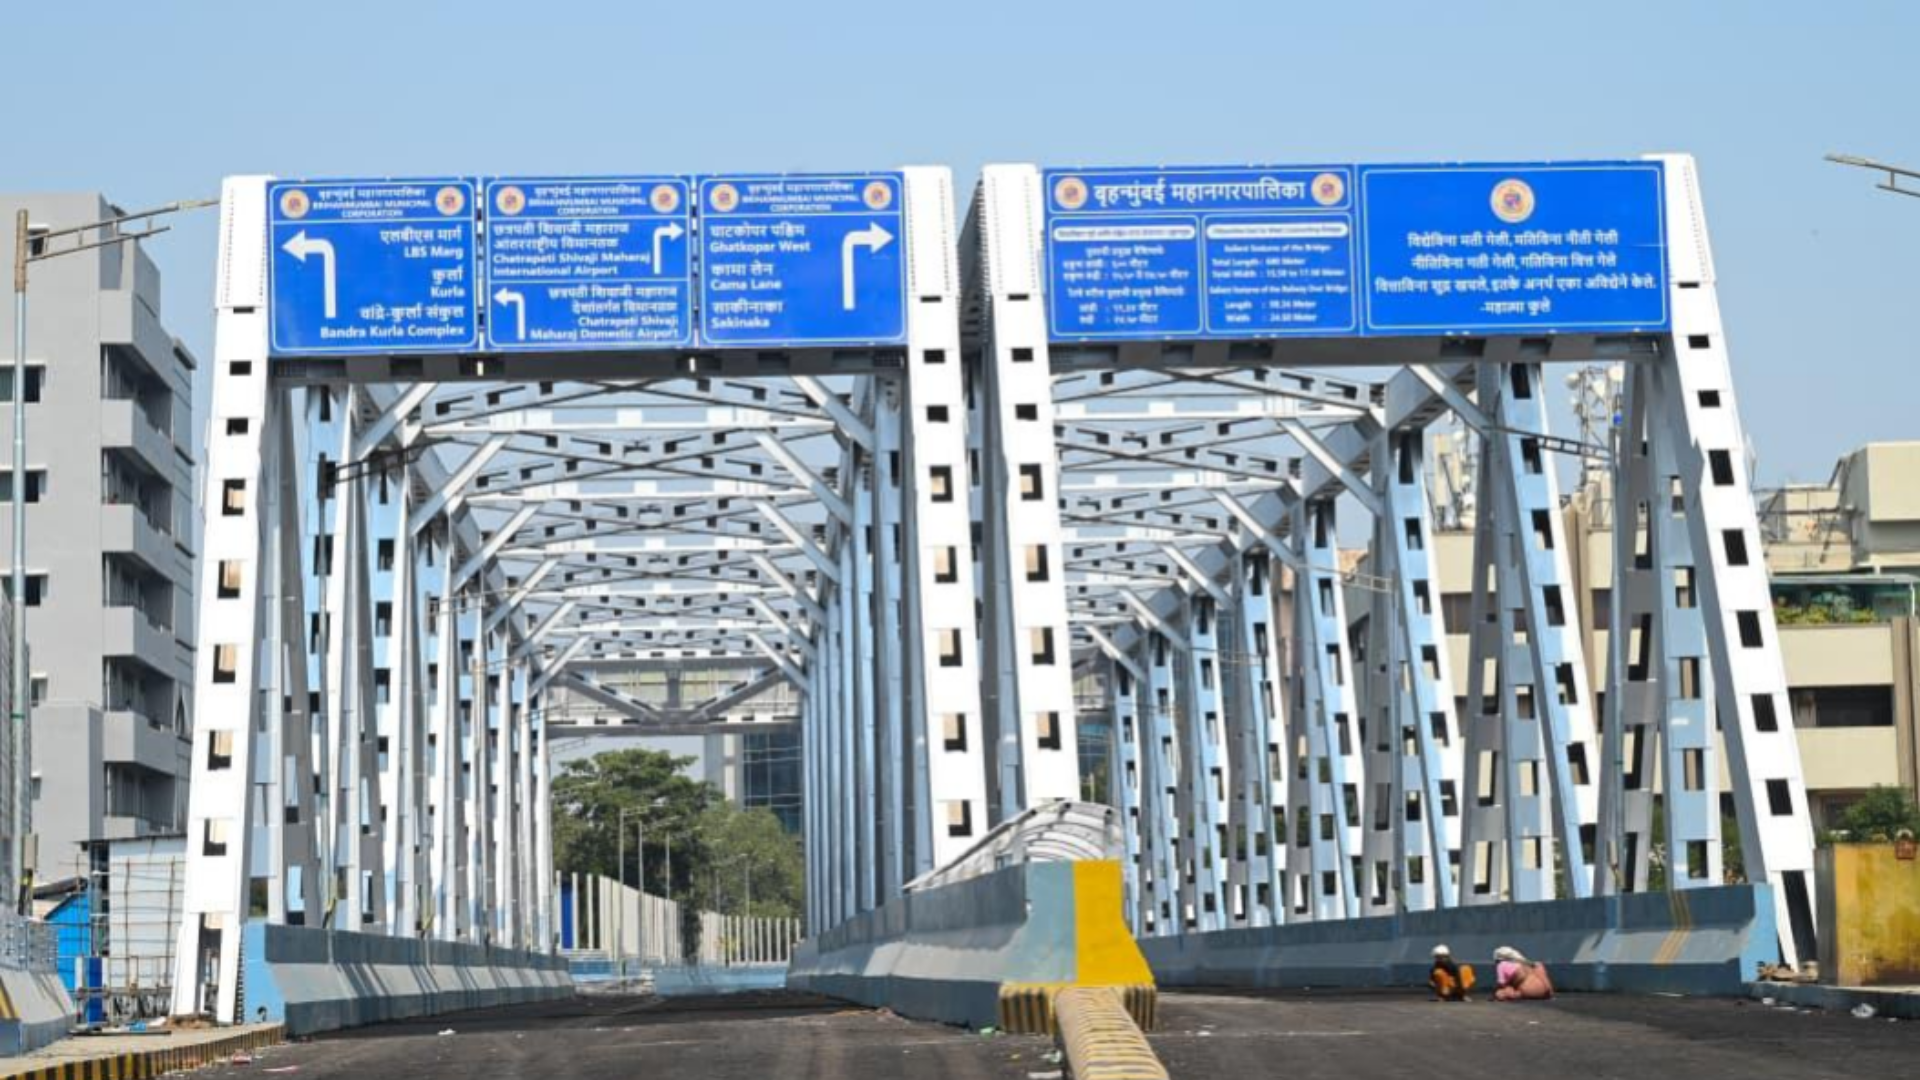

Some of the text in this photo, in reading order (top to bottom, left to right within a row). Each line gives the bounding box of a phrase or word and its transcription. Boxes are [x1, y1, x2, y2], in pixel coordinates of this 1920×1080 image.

[1094, 177, 1305, 207] बृहन्मुंबई महानगरपालिका
[341, 209, 403, 218] CORPORATION
[557, 207, 619, 215] CORPORATION
[770, 204, 832, 212] CORPORATION
[380, 225, 462, 244] एलबीएस मार्ग
[538, 221, 581, 234] शिवाजी
[585, 222, 629, 235] महाराज
[710, 222, 766, 238] घाटकोपर
[1595, 229, 1618, 245] गेली
[404, 246, 463, 260] LBS Marg
[710, 241, 810, 254] Ghatkopar West
[493, 253, 650, 265] Chatrapati Shivaji Maharaj
[493, 265, 617, 277] International Airport
[711, 261, 774, 276] कामा लेन
[432, 267, 463, 285] कुर्ला
[710, 279, 781, 291] Cama Lane
[1557, 277, 1580, 291] एका
[431, 286, 465, 298] Kurla
[426, 304, 464, 321] संकुल
[1528, 298, 1550, 316] फुले
[578, 315, 678, 327] Chatrapati Shivaji
[711, 317, 770, 329] Sakinaka
[321, 325, 465, 339] Bandra Kurla Complex
[531, 329, 679, 341] Maharaj Domestic Airport
